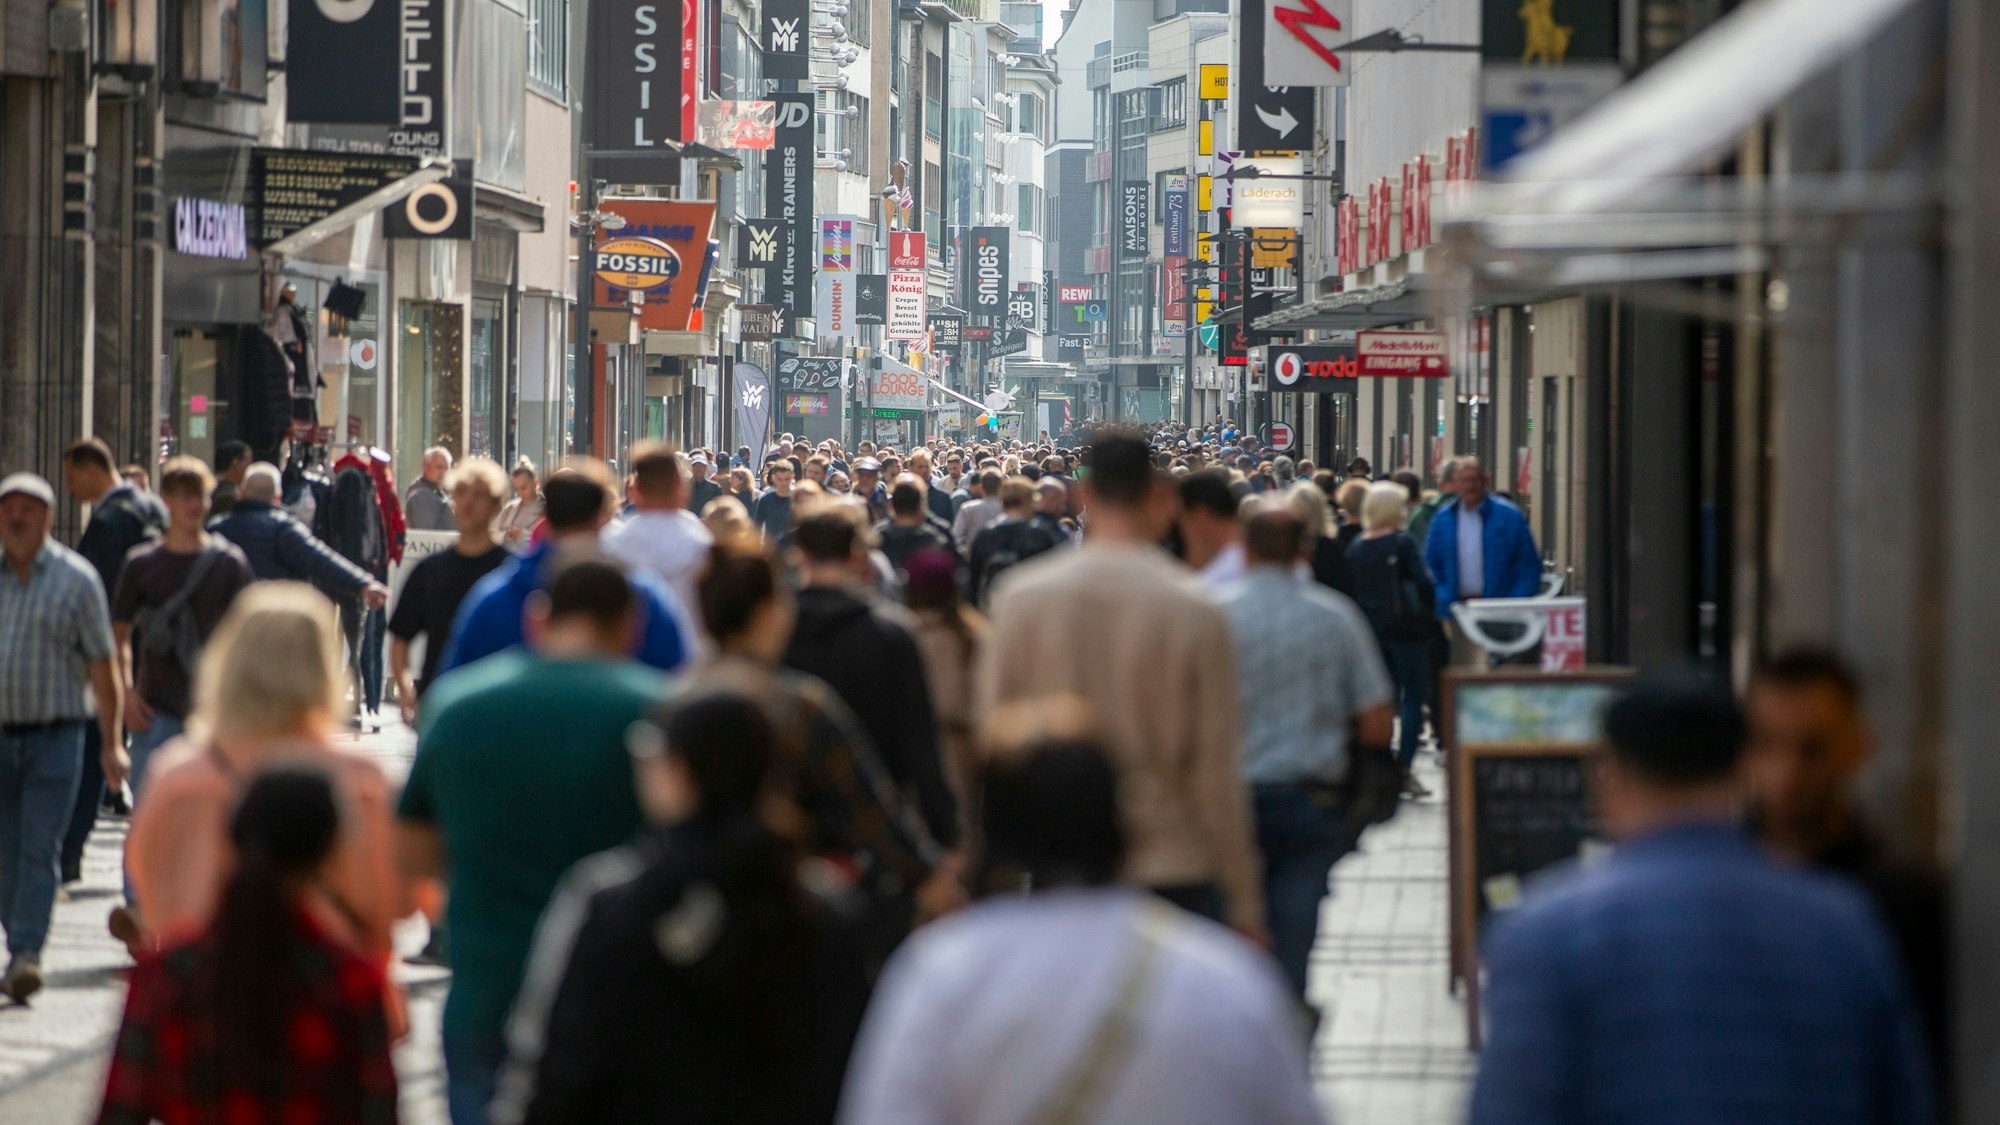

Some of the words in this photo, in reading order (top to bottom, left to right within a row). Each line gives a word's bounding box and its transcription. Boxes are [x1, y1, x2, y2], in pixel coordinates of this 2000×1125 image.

[771, 18, 799, 52] WMF
[388, 131, 440, 145] OUNG
[1125, 186, 1136, 250] MAISONS
[1170, 210, 1178, 252] Eenthaus
[749, 226, 778, 261] WMF
[1140, 237, 1146, 250] DU
[597, 253, 670, 274] FOSSIL
[894, 256, 920, 266] CocaCola
[978, 245, 1002, 305] snipes
[892, 284, 922, 294] König
[744, 312, 771, 322] LBEN
[1366, 356, 1421, 369] EINGANG
[881, 373, 918, 385] FOOD
